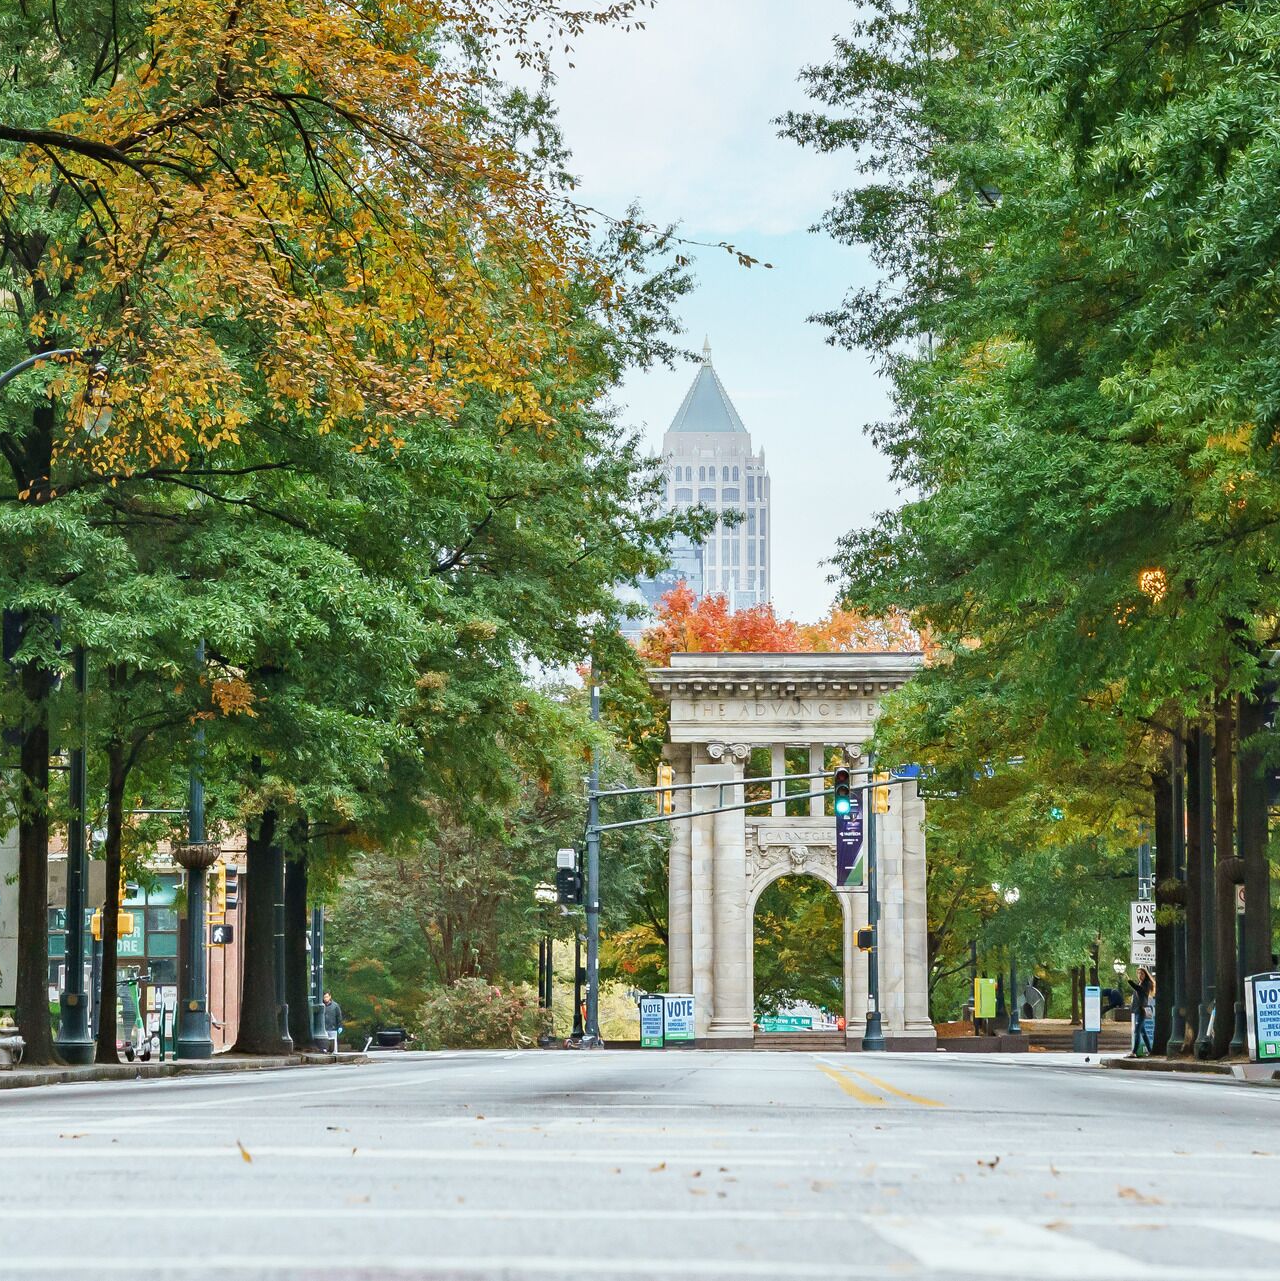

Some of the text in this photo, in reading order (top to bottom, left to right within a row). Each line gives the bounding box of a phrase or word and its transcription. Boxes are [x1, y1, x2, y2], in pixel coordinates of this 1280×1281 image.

[690, 703, 874, 717] THE ADVANCEME
[766, 832, 832, 841] CARNEGIE
[1136, 905, 1156, 913] ONE
[643, 1004, 661, 1013] VOTE
[667, 1000, 693, 1017] VOTE
